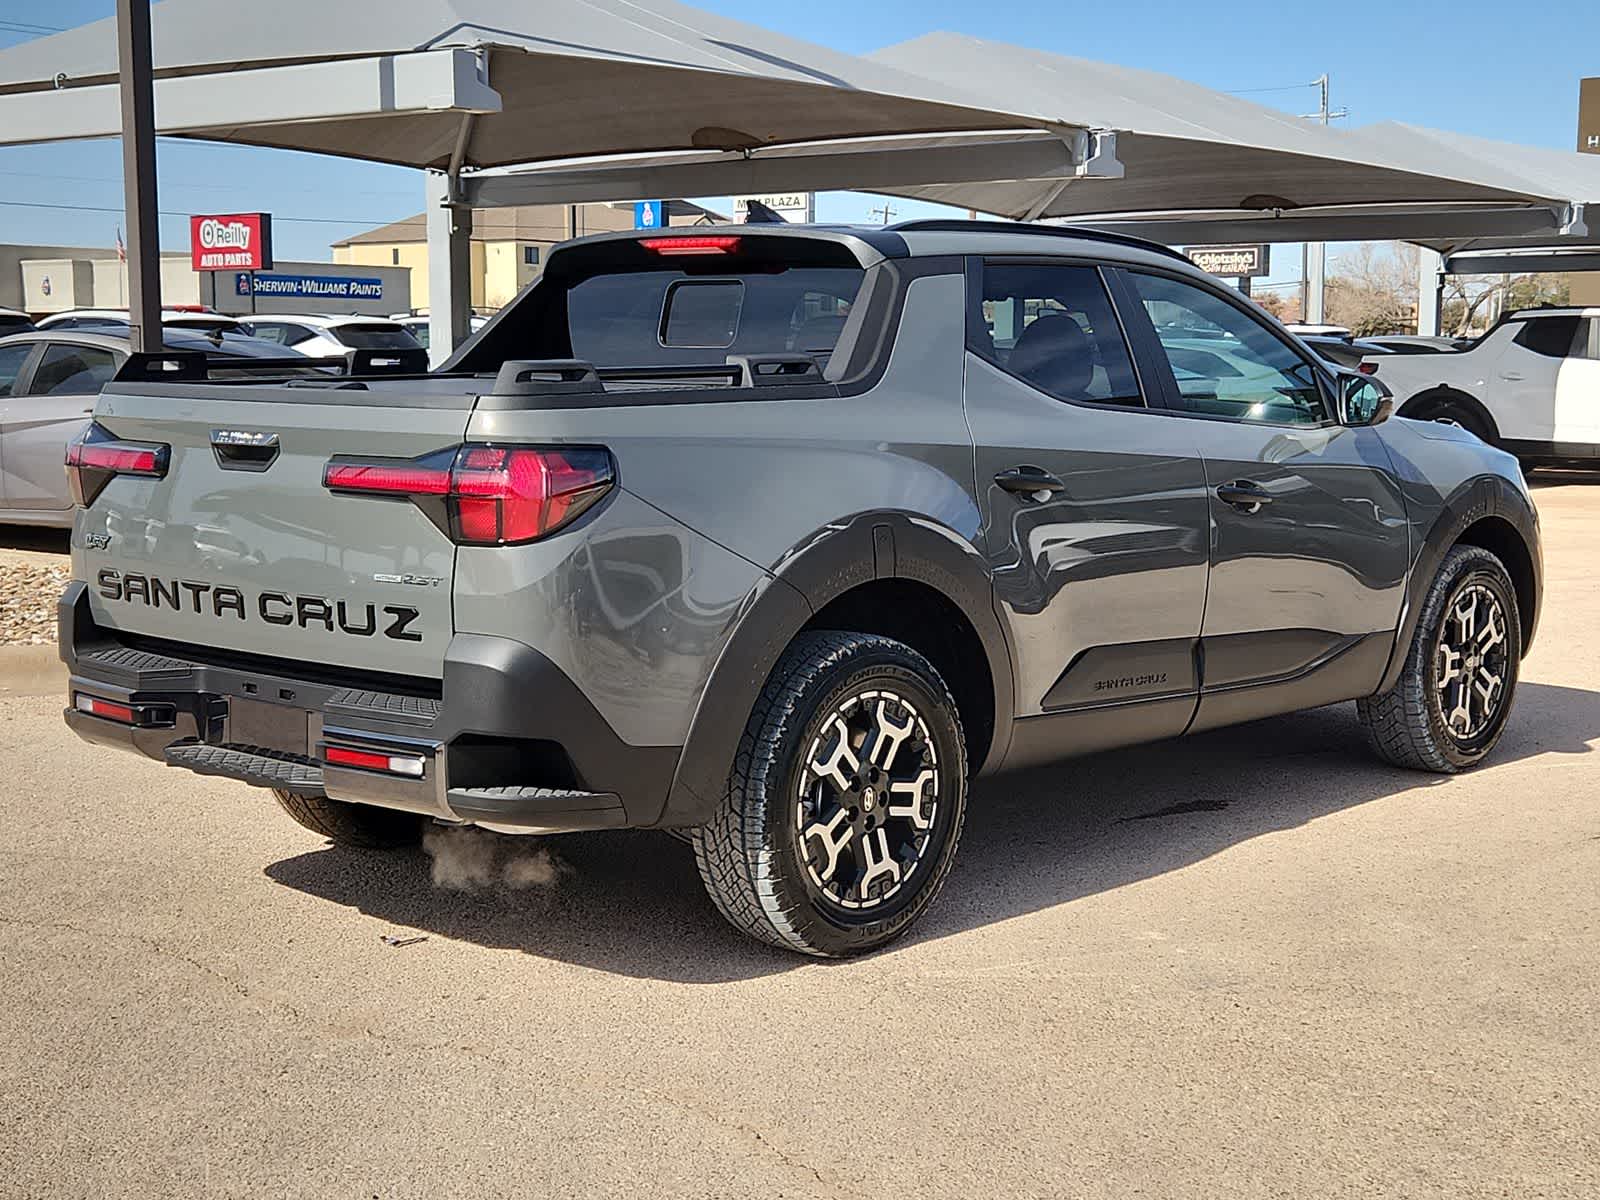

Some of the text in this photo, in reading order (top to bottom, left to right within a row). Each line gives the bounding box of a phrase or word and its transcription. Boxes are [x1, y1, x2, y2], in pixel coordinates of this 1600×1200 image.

[764, 196, 801, 207] PLAZA
[202, 222, 248, 247] O'Reilly
[201, 253, 252, 267] AUTO PARTS
[253, 278, 347, 295] SHERWIN-WILLIAMS
[350, 282, 383, 296] PAINTS
[97, 566, 424, 643] SANTA CRUZ
[1095, 672, 1168, 691] SANTA CRUZ
